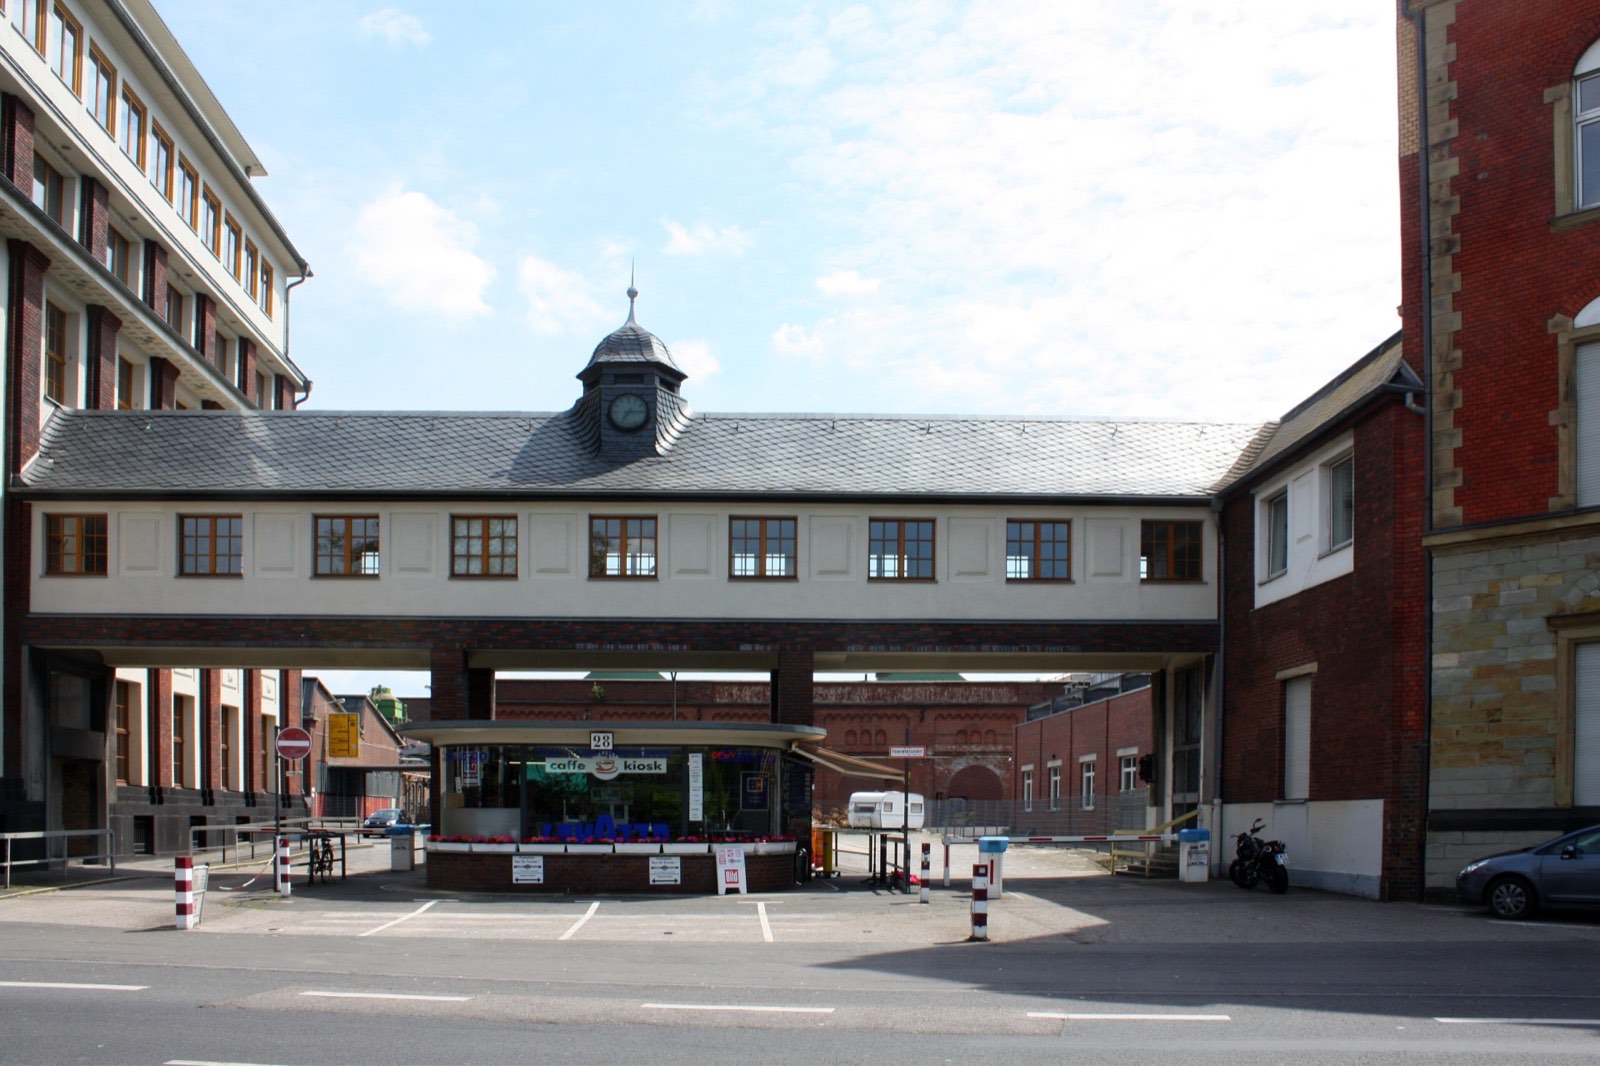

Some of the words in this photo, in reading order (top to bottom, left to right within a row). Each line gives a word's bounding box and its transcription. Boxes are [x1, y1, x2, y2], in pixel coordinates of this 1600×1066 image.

[593, 735, 610, 748] 28
[550, 760, 586, 770] caffe
[624, 760, 662, 771] kiosk
